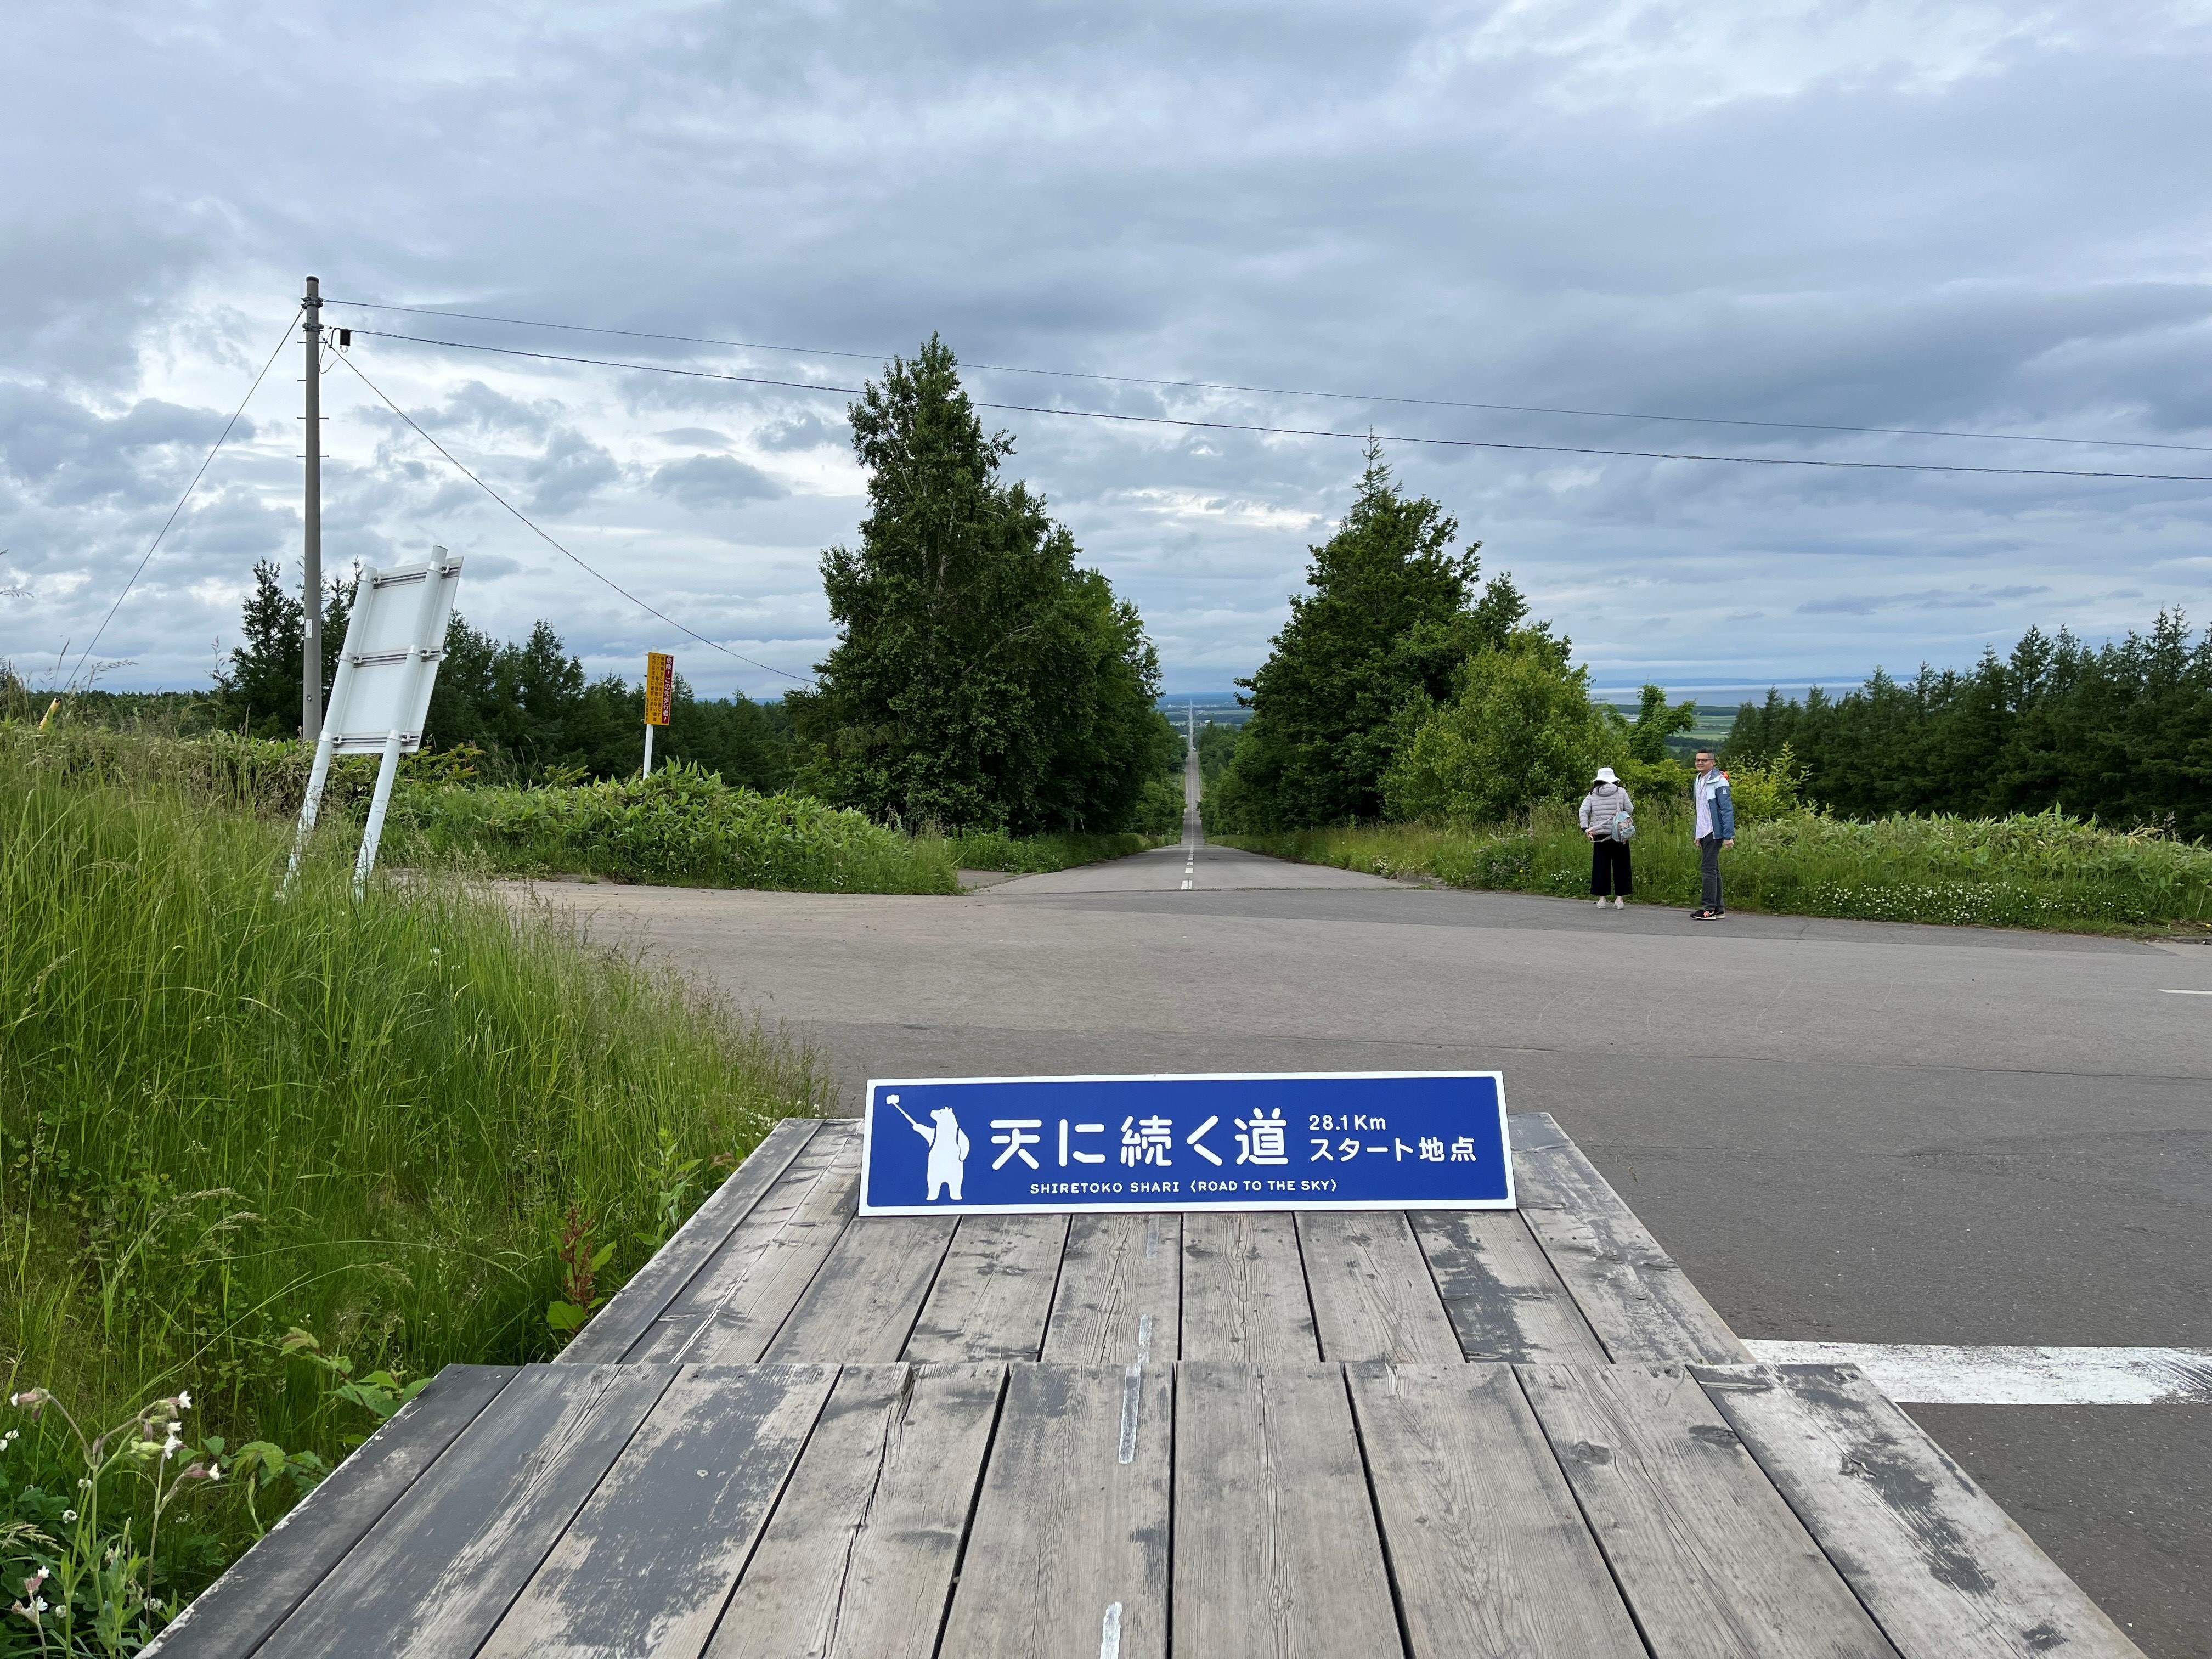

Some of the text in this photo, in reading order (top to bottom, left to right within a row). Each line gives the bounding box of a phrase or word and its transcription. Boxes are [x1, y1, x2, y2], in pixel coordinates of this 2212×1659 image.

[1309, 1114, 1386, 1131] 28.1Km
[990, 1108, 1289, 1171] 天に続く道
[1310, 1136, 1476, 1162] スタート地点
[1030, 1182, 1122, 1194] SHIRETOKO
[1130, 1181, 1180, 1193] SHARI
[1243, 1180, 1262, 1192] TO
[1267, 1180, 1295, 1191] THE
